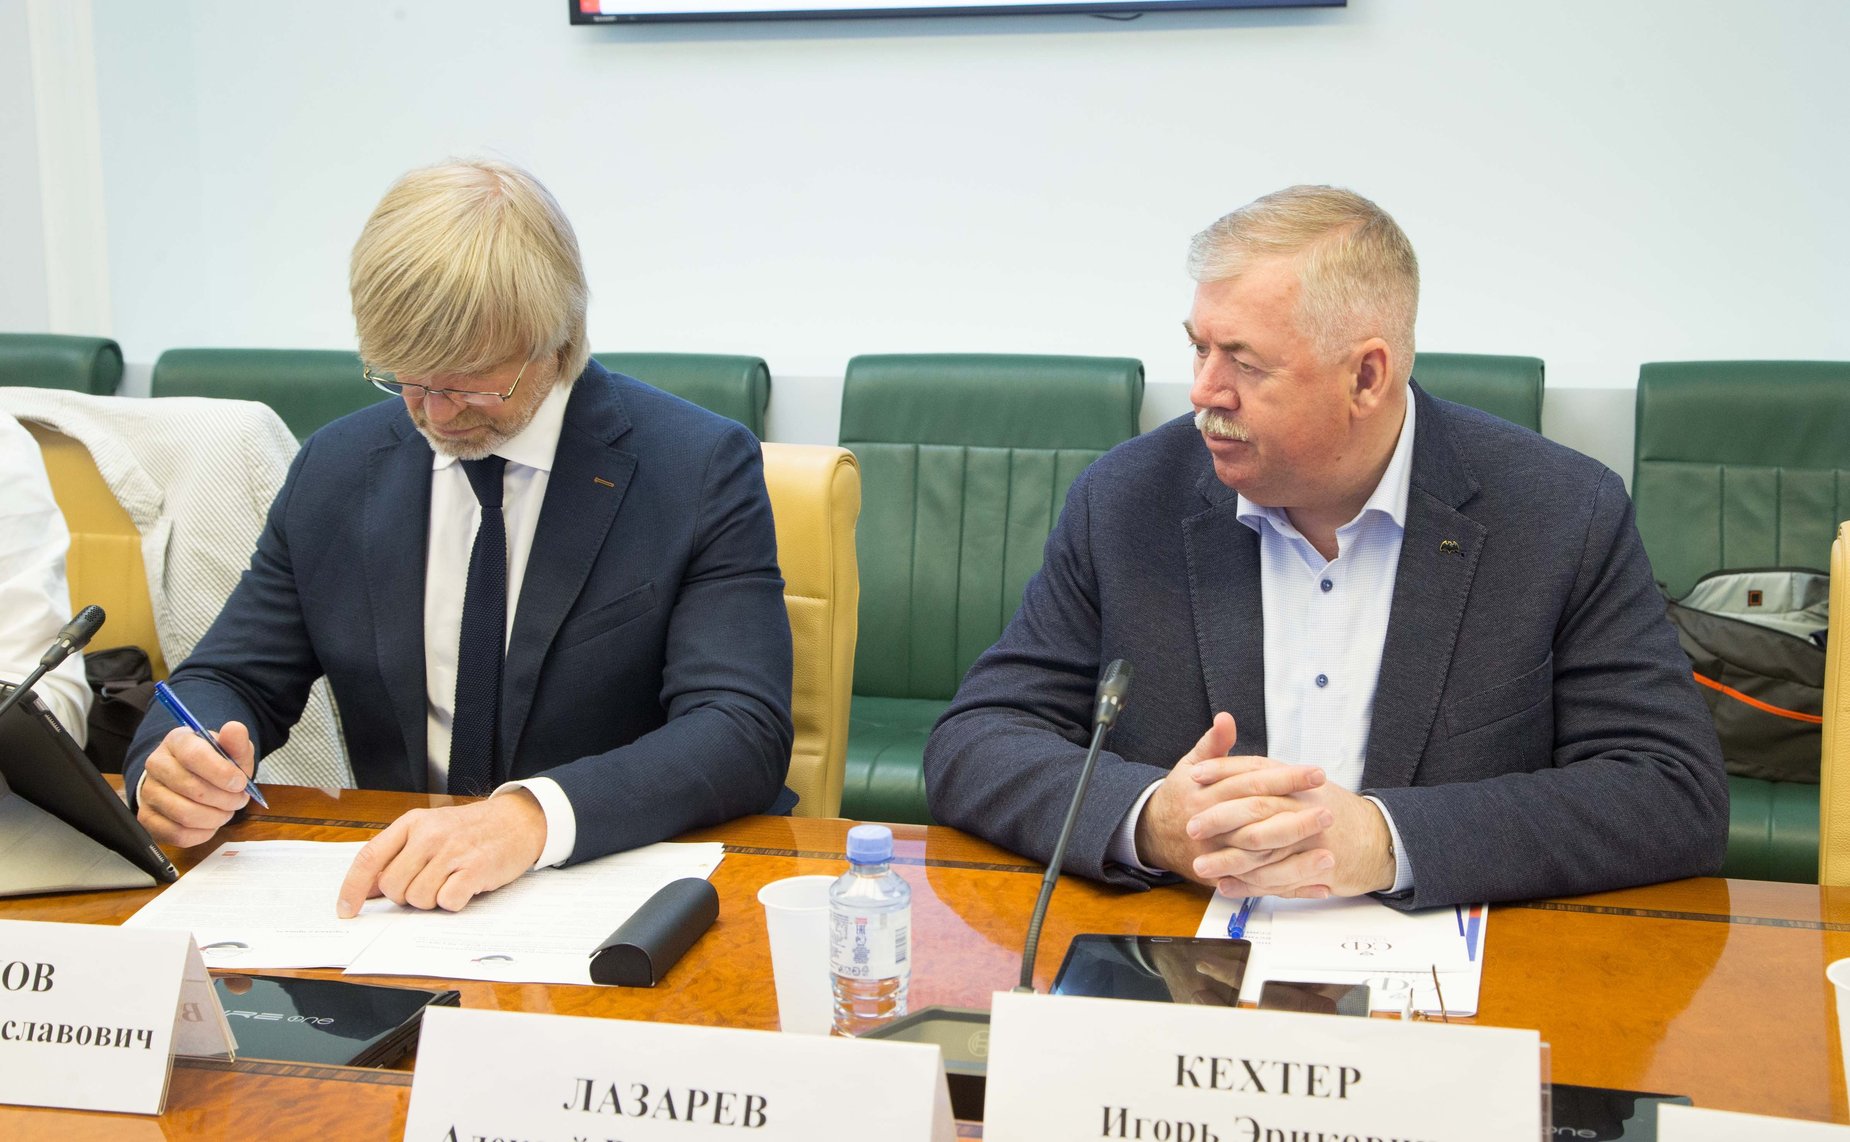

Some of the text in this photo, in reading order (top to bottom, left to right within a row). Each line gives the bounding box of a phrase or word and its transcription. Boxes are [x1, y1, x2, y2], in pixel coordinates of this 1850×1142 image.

[0, 960, 56, 993] ОВ
[1, 1019, 154, 1050] славович
[1173, 1053, 1362, 1100] КЕХТЕР
[562, 1078, 769, 1129] ЛАЗАРЕВ
[1101, 1105, 1220, 1142] Игорь
